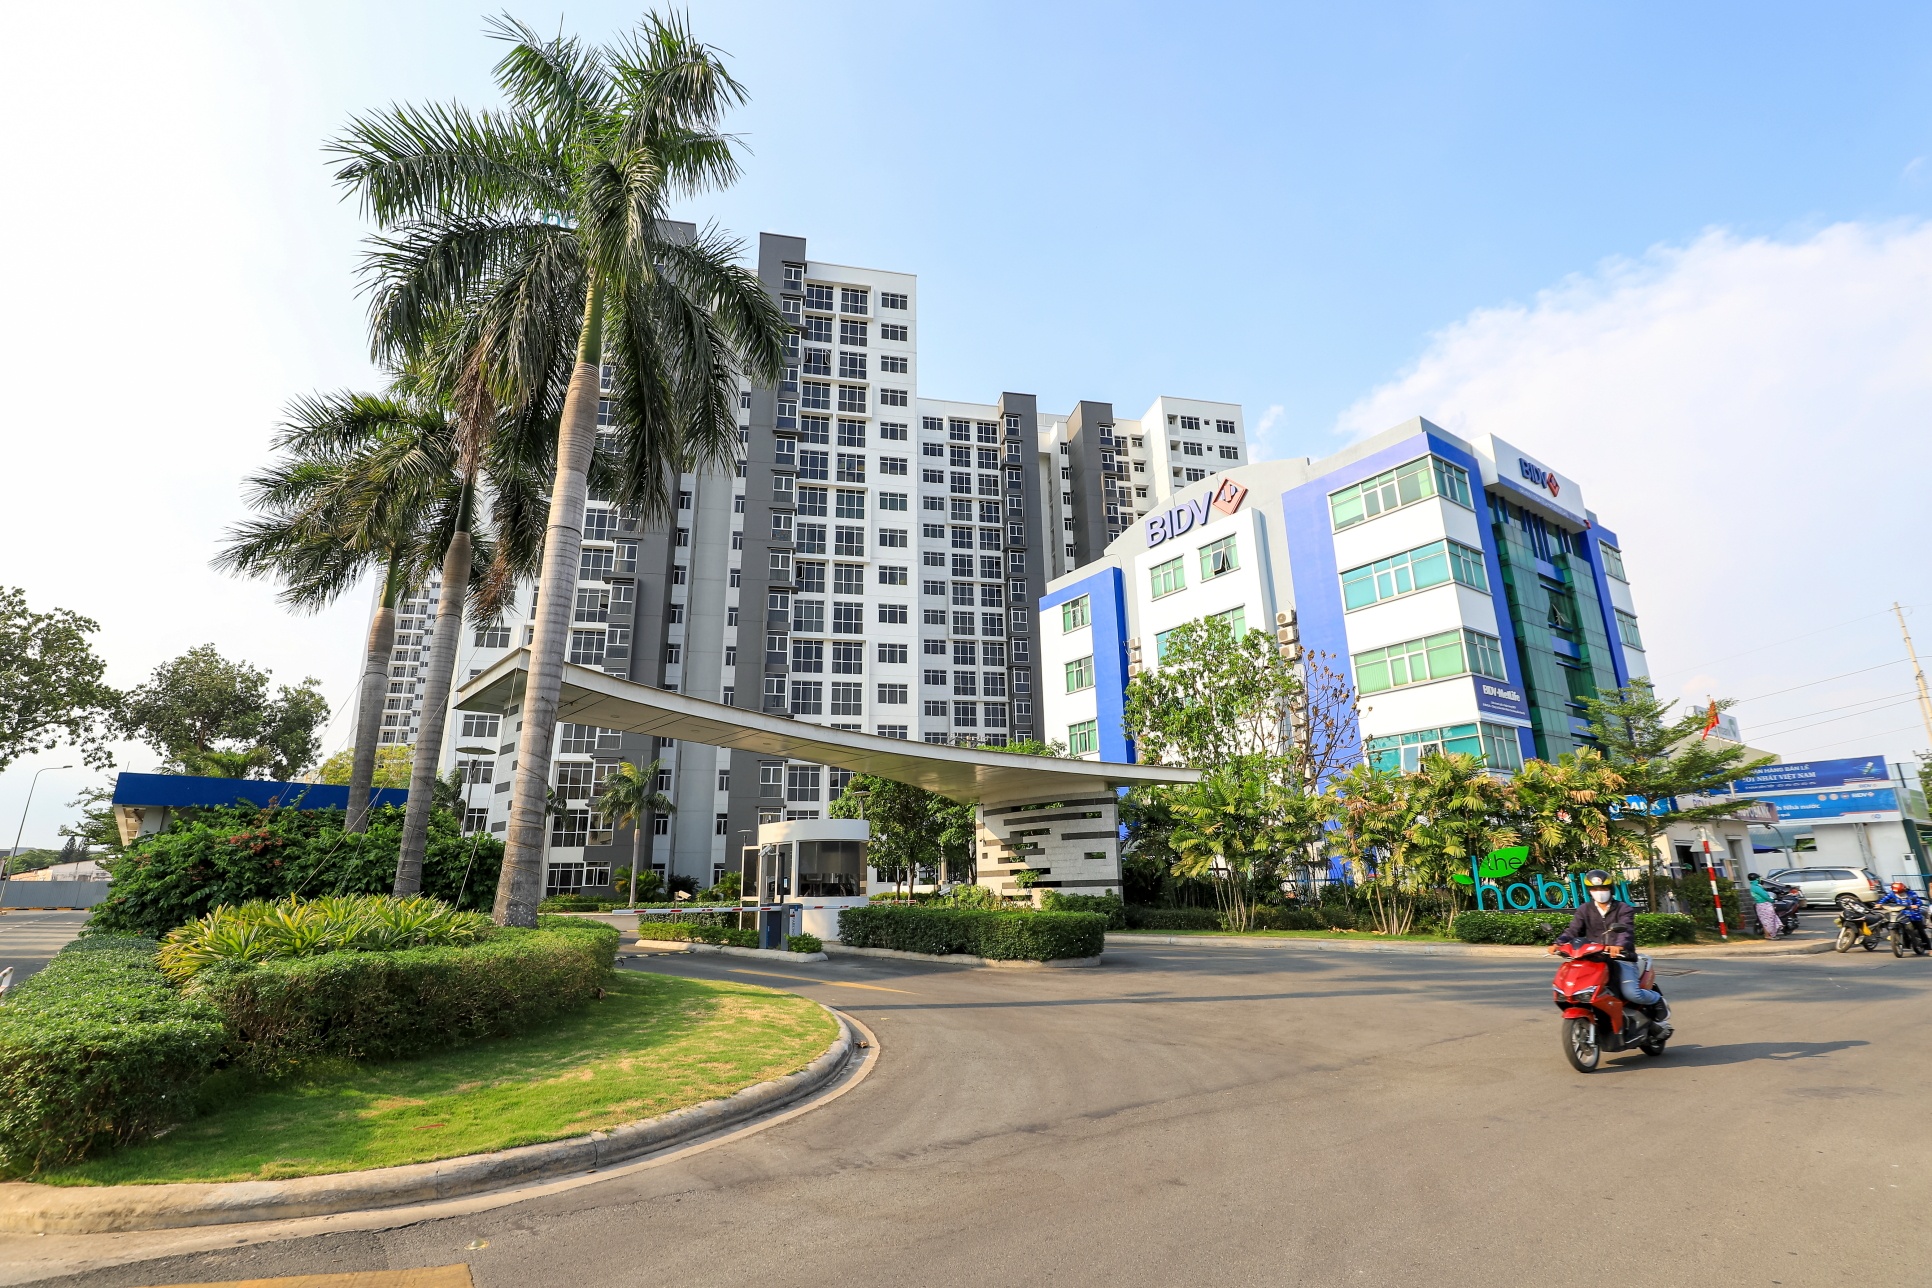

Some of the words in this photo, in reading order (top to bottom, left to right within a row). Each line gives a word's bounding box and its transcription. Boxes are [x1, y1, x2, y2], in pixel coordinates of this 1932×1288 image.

[1518, 457, 1547, 490] BIDV
[1144, 491, 1213, 549] BIDV
[1779, 773, 1797, 781] VIỆT
[1798, 771, 1816, 779] NAM
[1486, 853, 1523, 871] the
